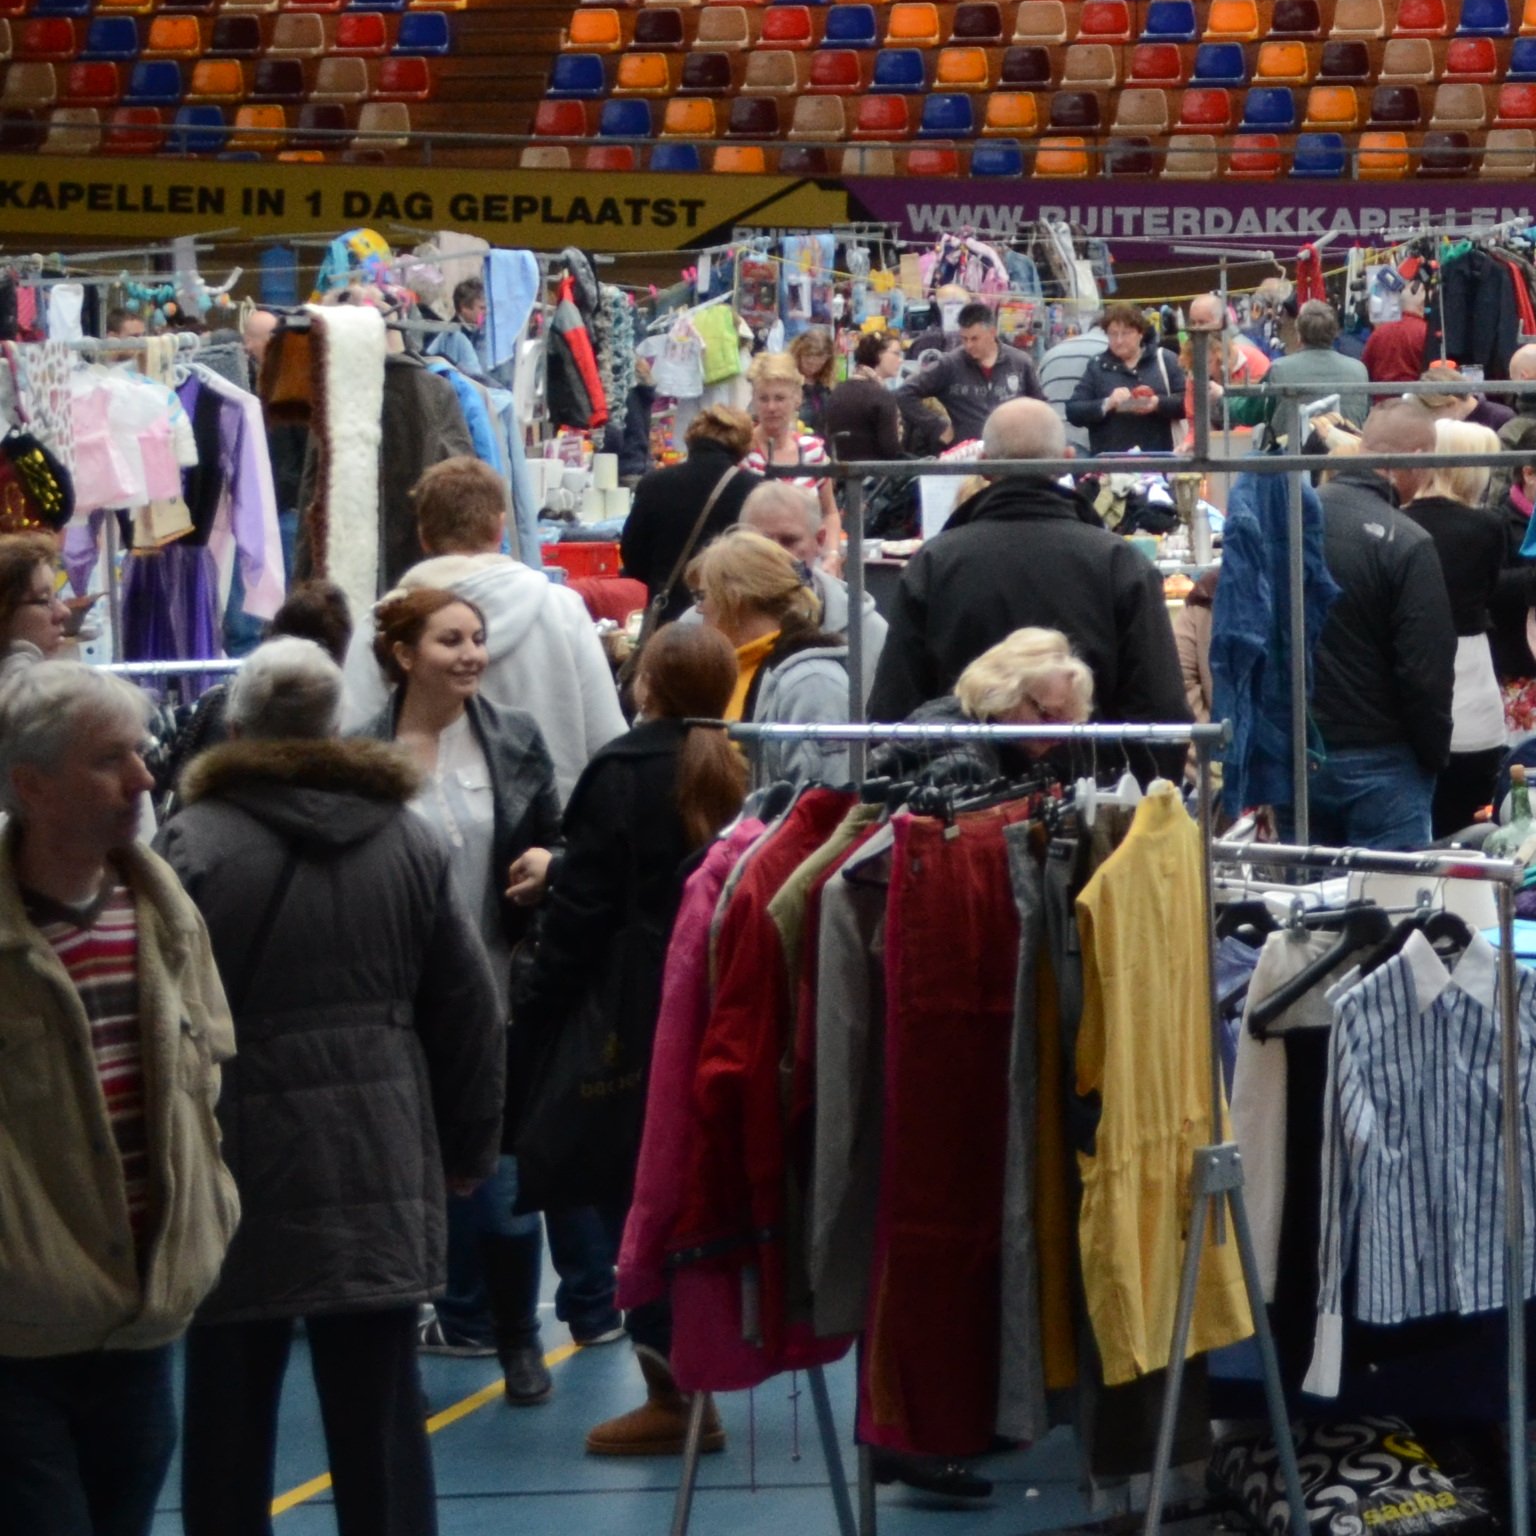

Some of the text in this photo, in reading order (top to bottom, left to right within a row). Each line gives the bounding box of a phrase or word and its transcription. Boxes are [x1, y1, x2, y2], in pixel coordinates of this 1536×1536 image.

[242, 187, 286, 217] IN
[305, 190, 323, 218] 1
[343, 190, 433, 222] DAG
[449, 193, 705, 227] GEPLAATST
